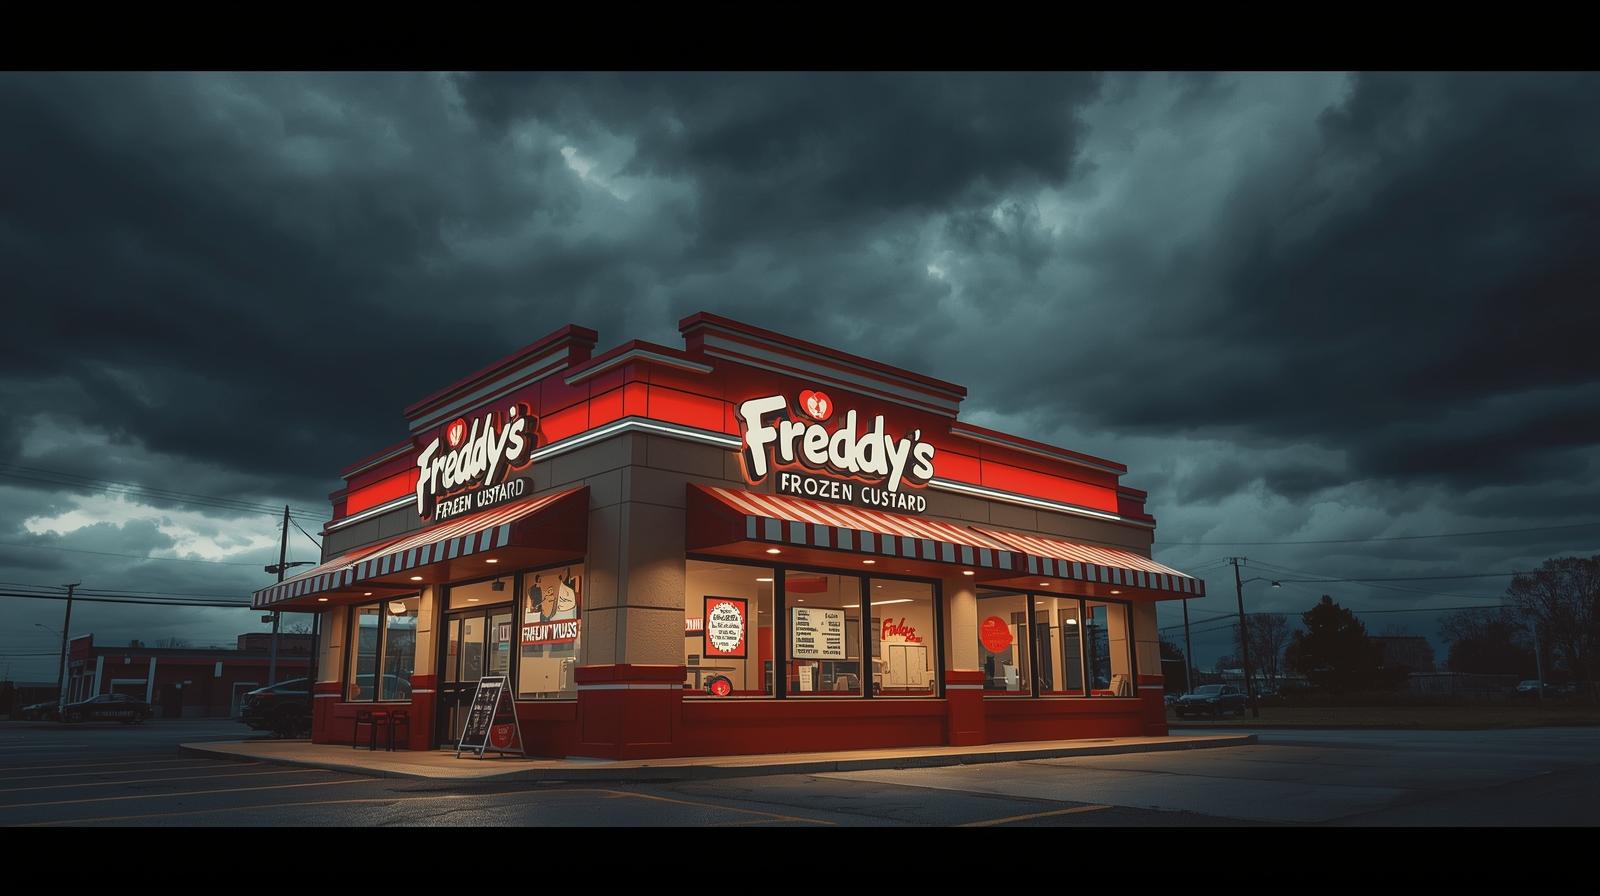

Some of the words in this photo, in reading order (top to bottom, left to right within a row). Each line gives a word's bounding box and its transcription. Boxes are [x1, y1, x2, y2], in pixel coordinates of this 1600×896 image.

[416, 406, 525, 515] Freddy's
[740, 395, 935, 492] Freddy's
[781, 473, 852, 501] FROZEN
[861, 486, 926, 512] CUSTARD
